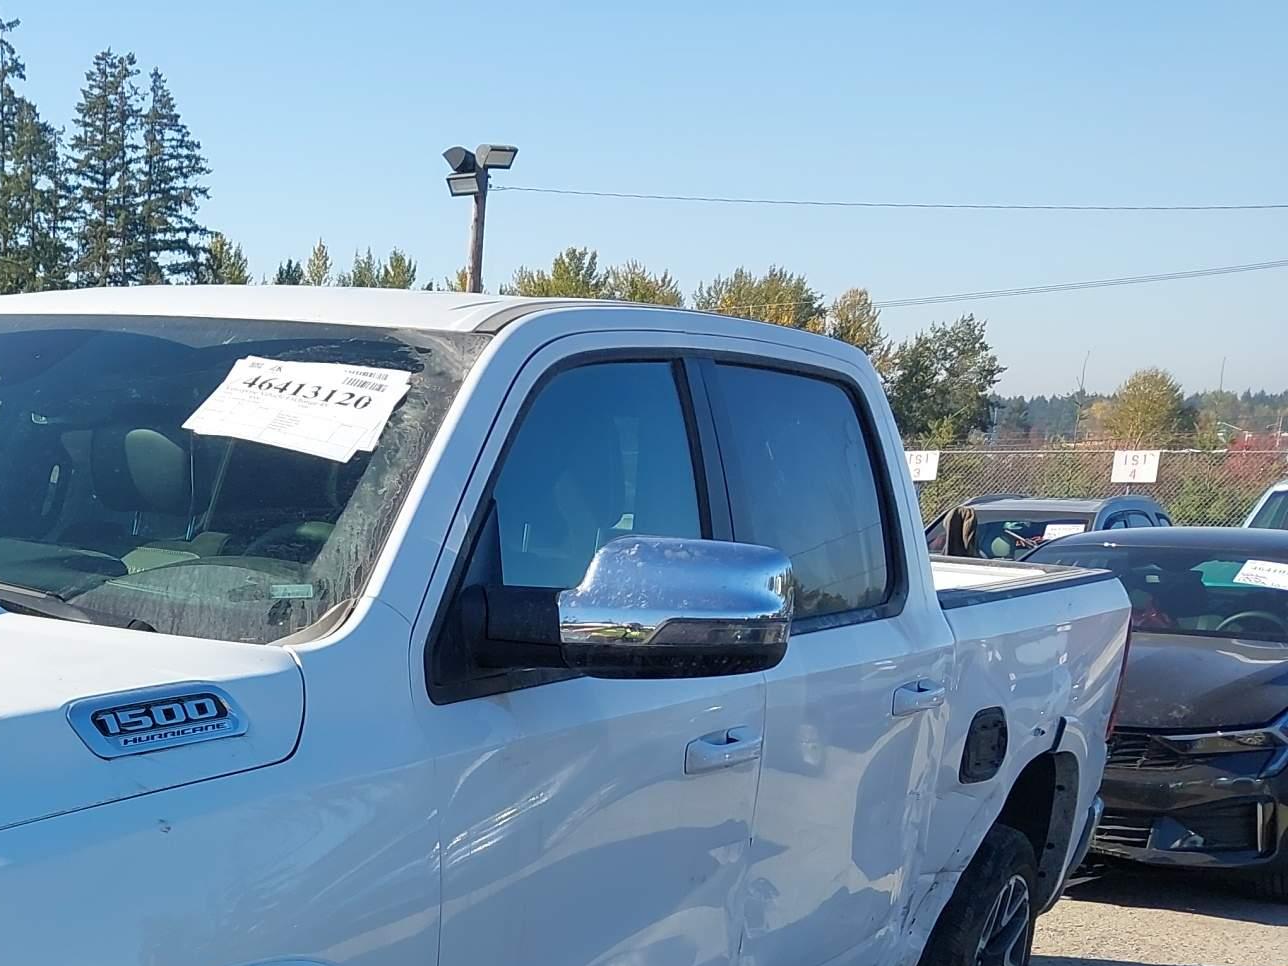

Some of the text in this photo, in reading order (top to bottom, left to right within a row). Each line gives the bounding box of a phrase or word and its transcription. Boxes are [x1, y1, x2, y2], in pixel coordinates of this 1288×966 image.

[242, 375, 373, 410] 46413120
[96, 698, 218, 735] 1500
[123, 722, 227, 745] HURRICANE
